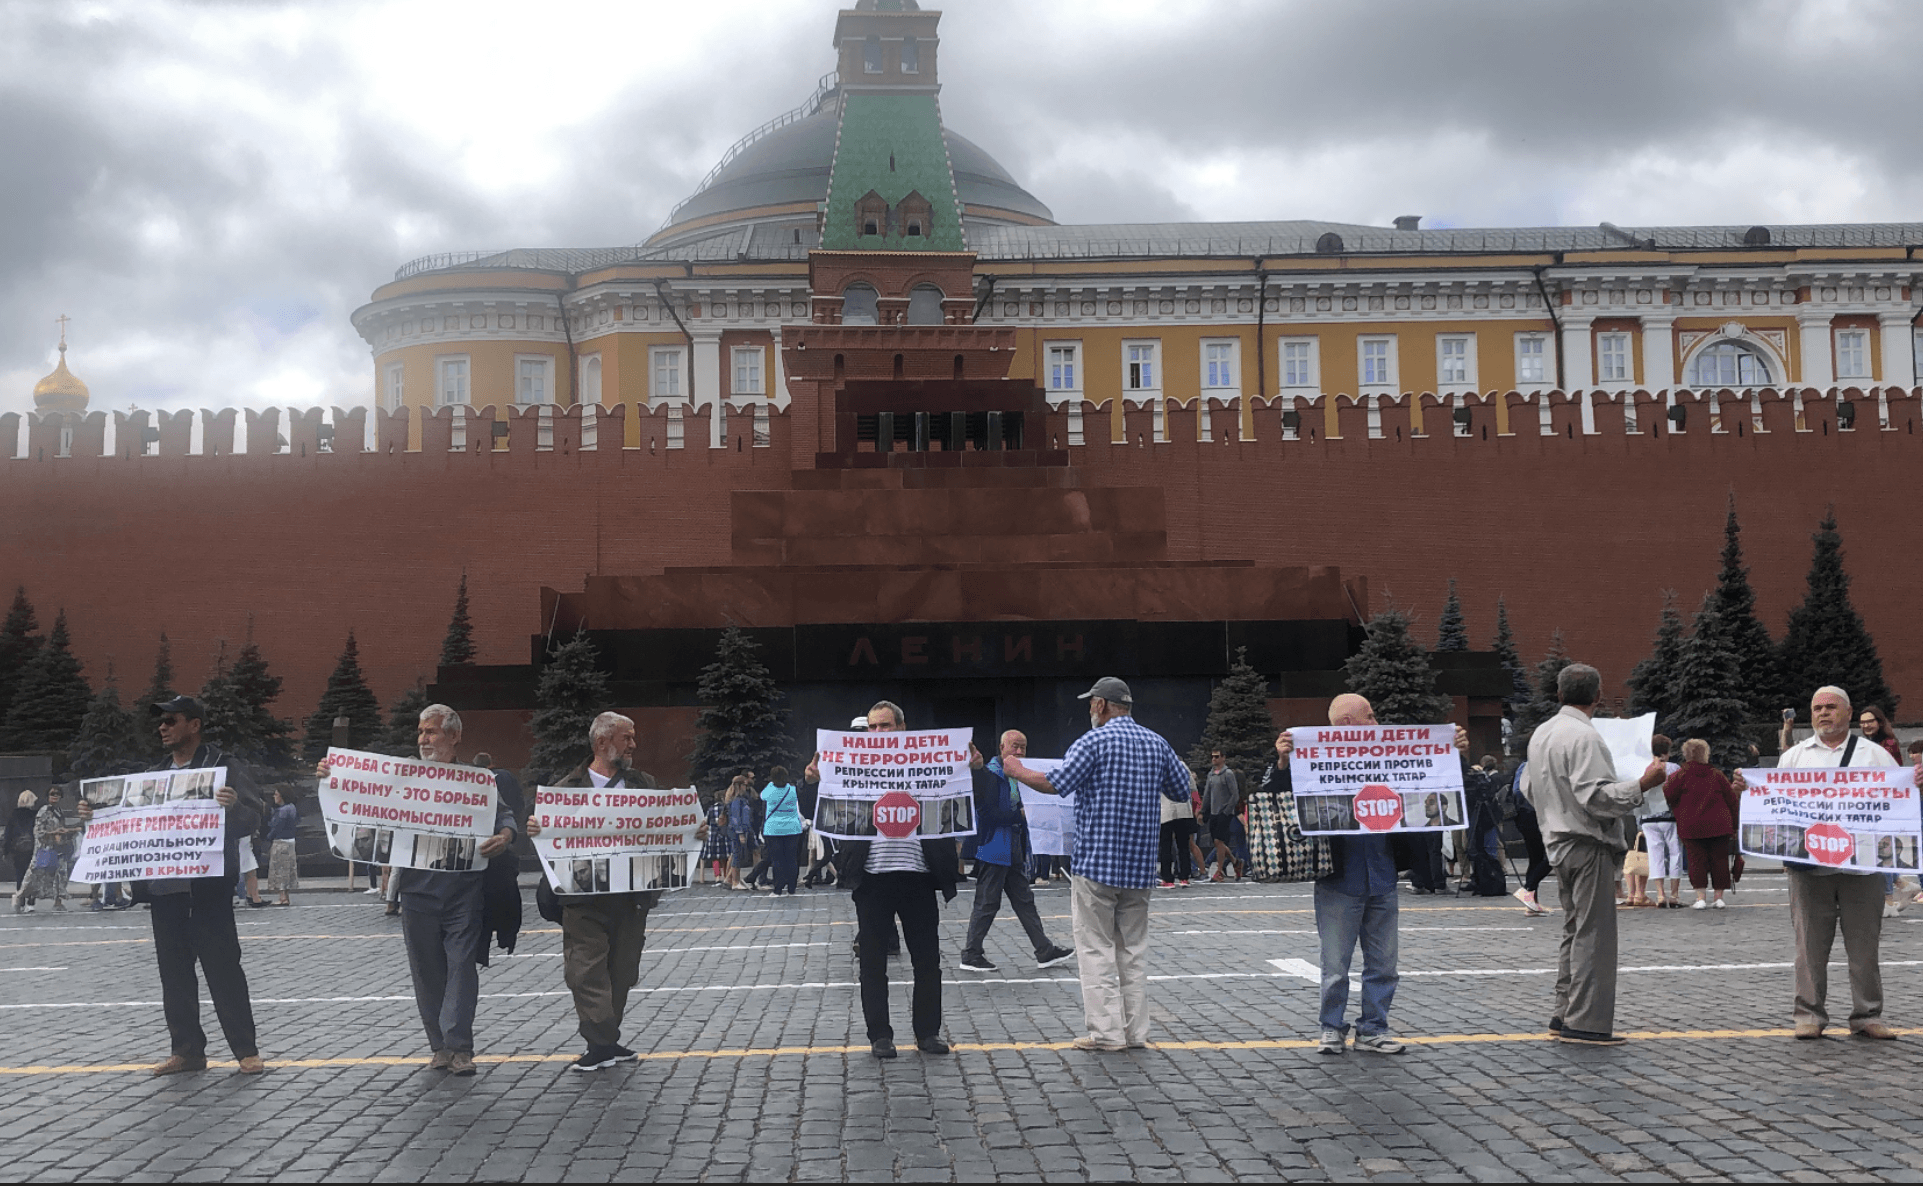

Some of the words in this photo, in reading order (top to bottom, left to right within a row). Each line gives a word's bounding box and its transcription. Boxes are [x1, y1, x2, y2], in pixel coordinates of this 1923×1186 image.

[850, 634, 1084, 665] ЛЕНИН
[842, 736, 898, 749] НАШИ
[904, 735, 949, 750] ДЕТИ
[1318, 730, 1375, 742] НАШИ
[1381, 728, 1430, 742] ДЕТИ
[822, 751, 844, 763] НЕ
[849, 750, 967, 765] ТЕРРОРИСТЫ
[1296, 747, 1319, 759] НЕ
[1325, 744, 1450, 758] ТЕРРОРИСТЫ
[328, 753, 378, 773] БОРЬБА
[382, 762, 390, 774] С
[394, 763, 496, 787] ТЕРРОРИЗМОМ
[835, 766, 904, 777] РЕПРЕССИИ
[908, 766, 953, 776] ПРОТИВ
[1311, 760, 1380, 771] РЕПРЕССИИ
[1384, 759, 1433, 769] ПРОТИВ
[843, 779, 911, 790] КРЫМСКИХ
[915, 779, 946, 789] ТАТАР
[1320, 773, 1389, 784] КРЫМСКИХ
[1392, 772, 1426, 782] ТАТАР
[1767, 772, 1827, 784] НАШИ
[1833, 771, 1885, 784] ДЕТИ
[330, 777, 338, 789] В
[342, 779, 392, 797] КРЫМУ
[403, 787, 430, 802] ЭТО
[434, 790, 488, 806] БОРЬБА
[536, 792, 589, 806] БОРЬБА
[592, 794, 601, 806] С
[1750, 784, 1770, 796] НЕ
[1776, 787, 1910, 799] ТЕРРОРИСТЫ
[1357, 799, 1398, 817] STOP
[1763, 797, 1833, 810] РЕПРЕССИИ
[1838, 801, 1890, 811] ПРОТИВ
[339, 802, 348, 814] С
[352, 803, 473, 828] ИНАКОМЫСЛИЕМ
[542, 815, 549, 827] В
[554, 816, 605, 830] КРЫМУ
[616, 817, 642, 829] ЭТО
[646, 814, 697, 828] БОРЬБА
[877, 806, 917, 823] STOP
[1771, 808, 1842, 822] КРЫМСКИХ
[1846, 814, 1882, 823] ТАТАР
[145, 814, 219, 832] РЕПРЕССИИ
[87, 846, 101, 854] ПО
[102, 837, 216, 853] НАЦИОНАЛЬНОМУ
[553, 838, 561, 849] С
[566, 834, 683, 848] ИНАКОМЫСЛИЕМ
[1808, 833, 1849, 852] STOP
[102, 851, 202, 866] РЕЛИГИОЗНОМУ
[85, 868, 142, 880] ПРИЗНАКУ
[146, 868, 153, 876] В
[158, 865, 210, 875] КРЫМУ
